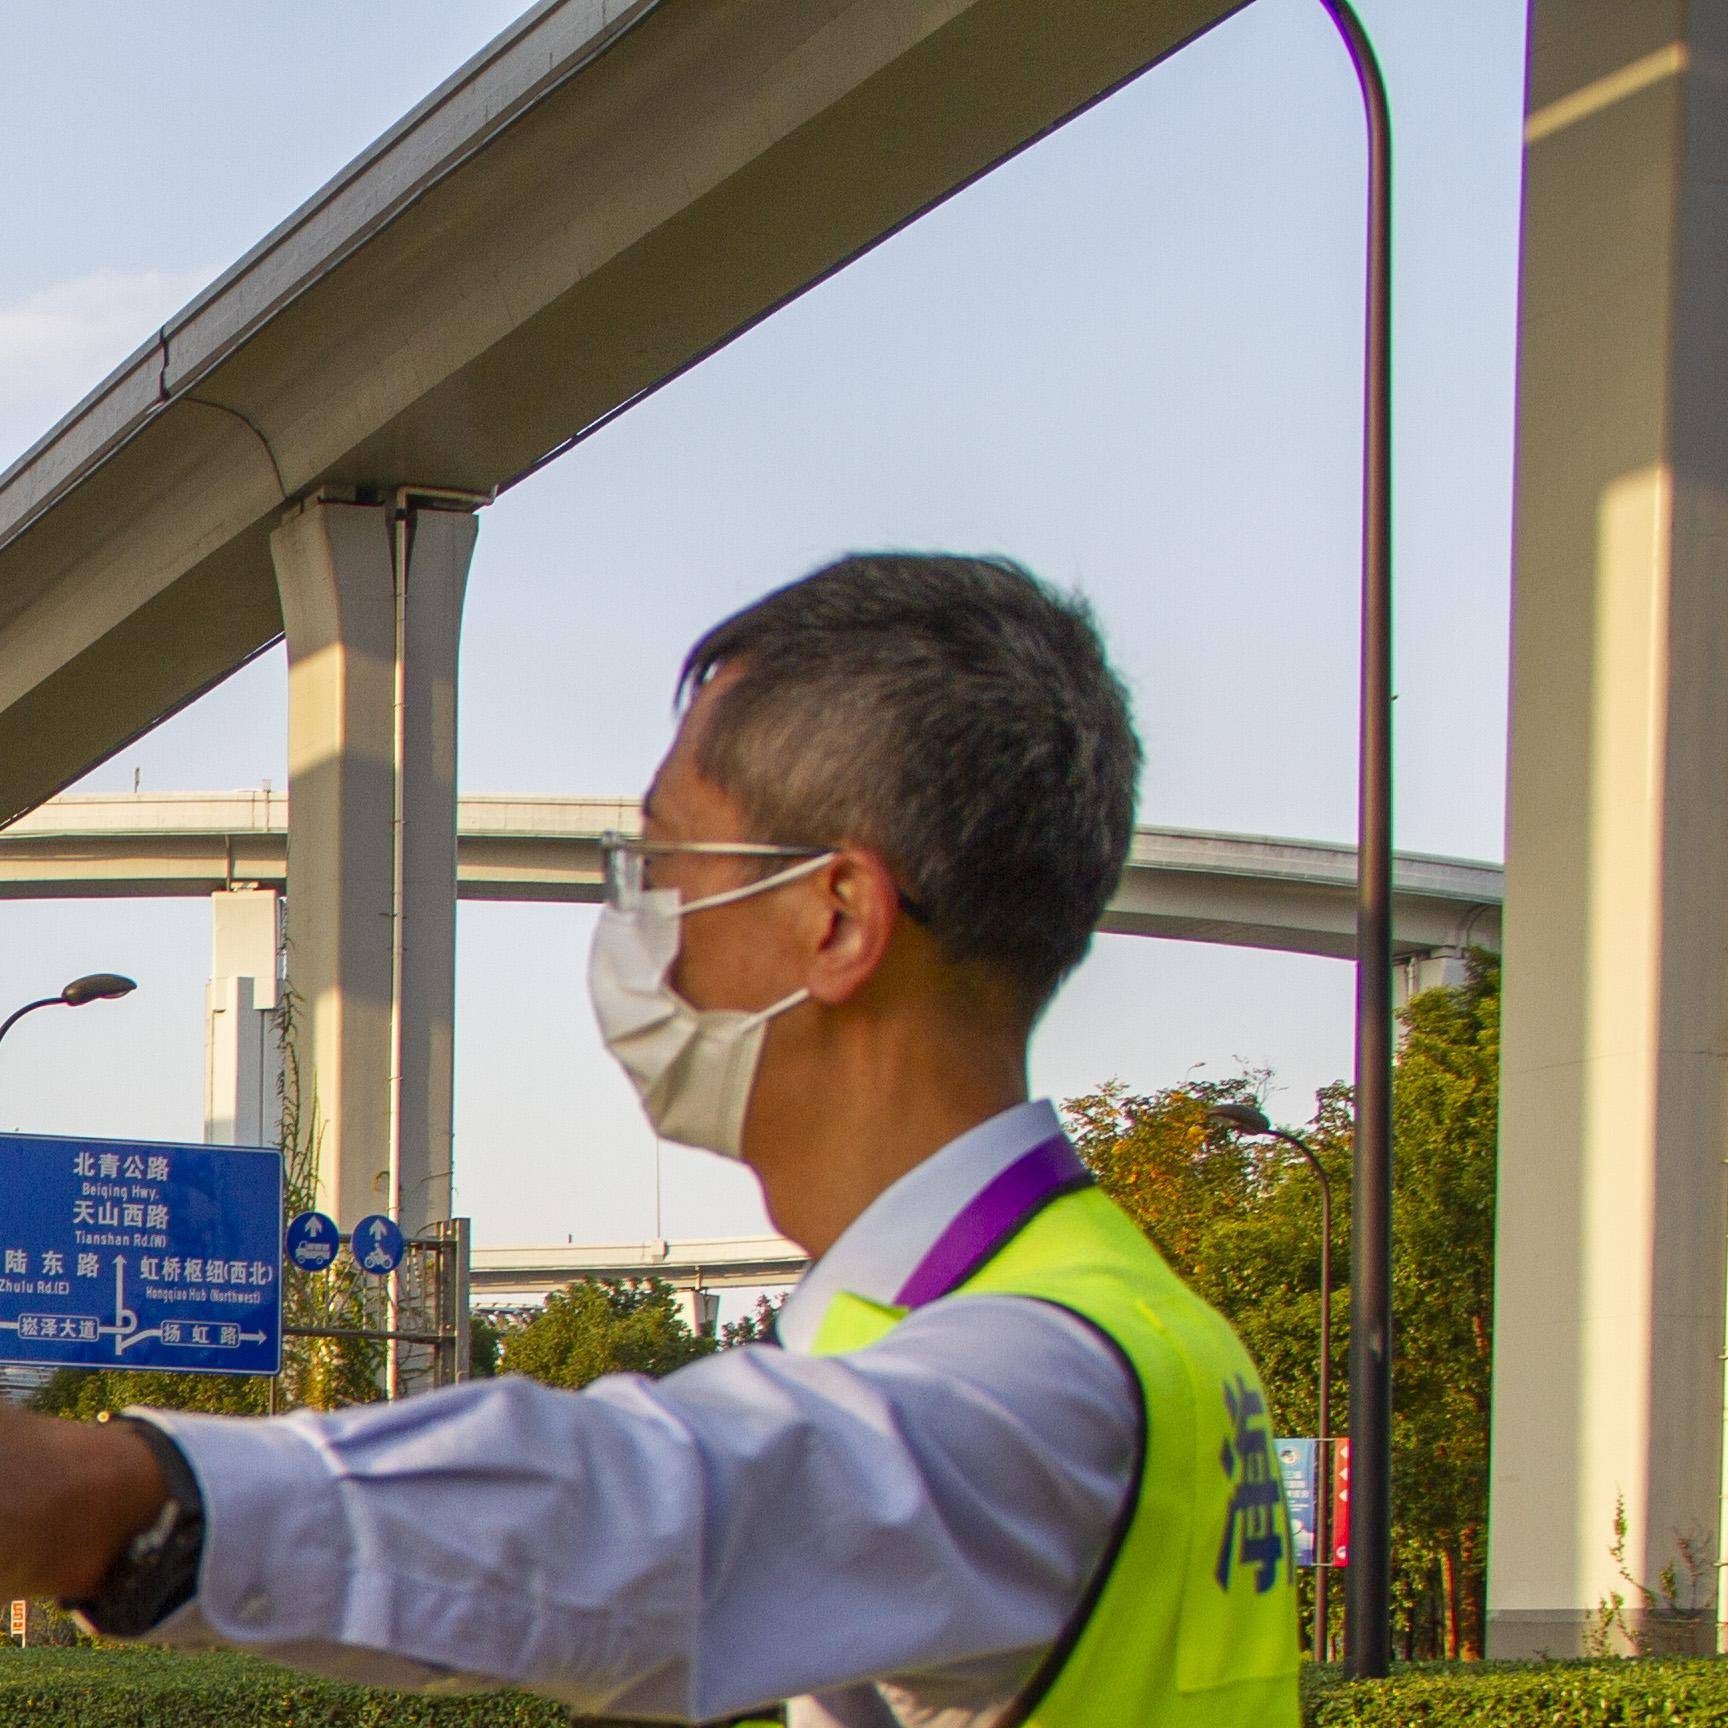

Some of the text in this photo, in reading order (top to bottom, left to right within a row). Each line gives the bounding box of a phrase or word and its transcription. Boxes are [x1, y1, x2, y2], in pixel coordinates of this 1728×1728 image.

[73, 1151, 171, 1182] 北青公路
[82, 1182, 159, 1201] Beiqing Hwy.
[73, 1200, 170, 1230] 天山西路
[75, 1230, 130, 1246] Tianshan
[146, 1286, 187, 1303] Hongqiao
[188, 1287, 206, 1301] Hub
[163, 1323, 238, 1347] 扬虹路
